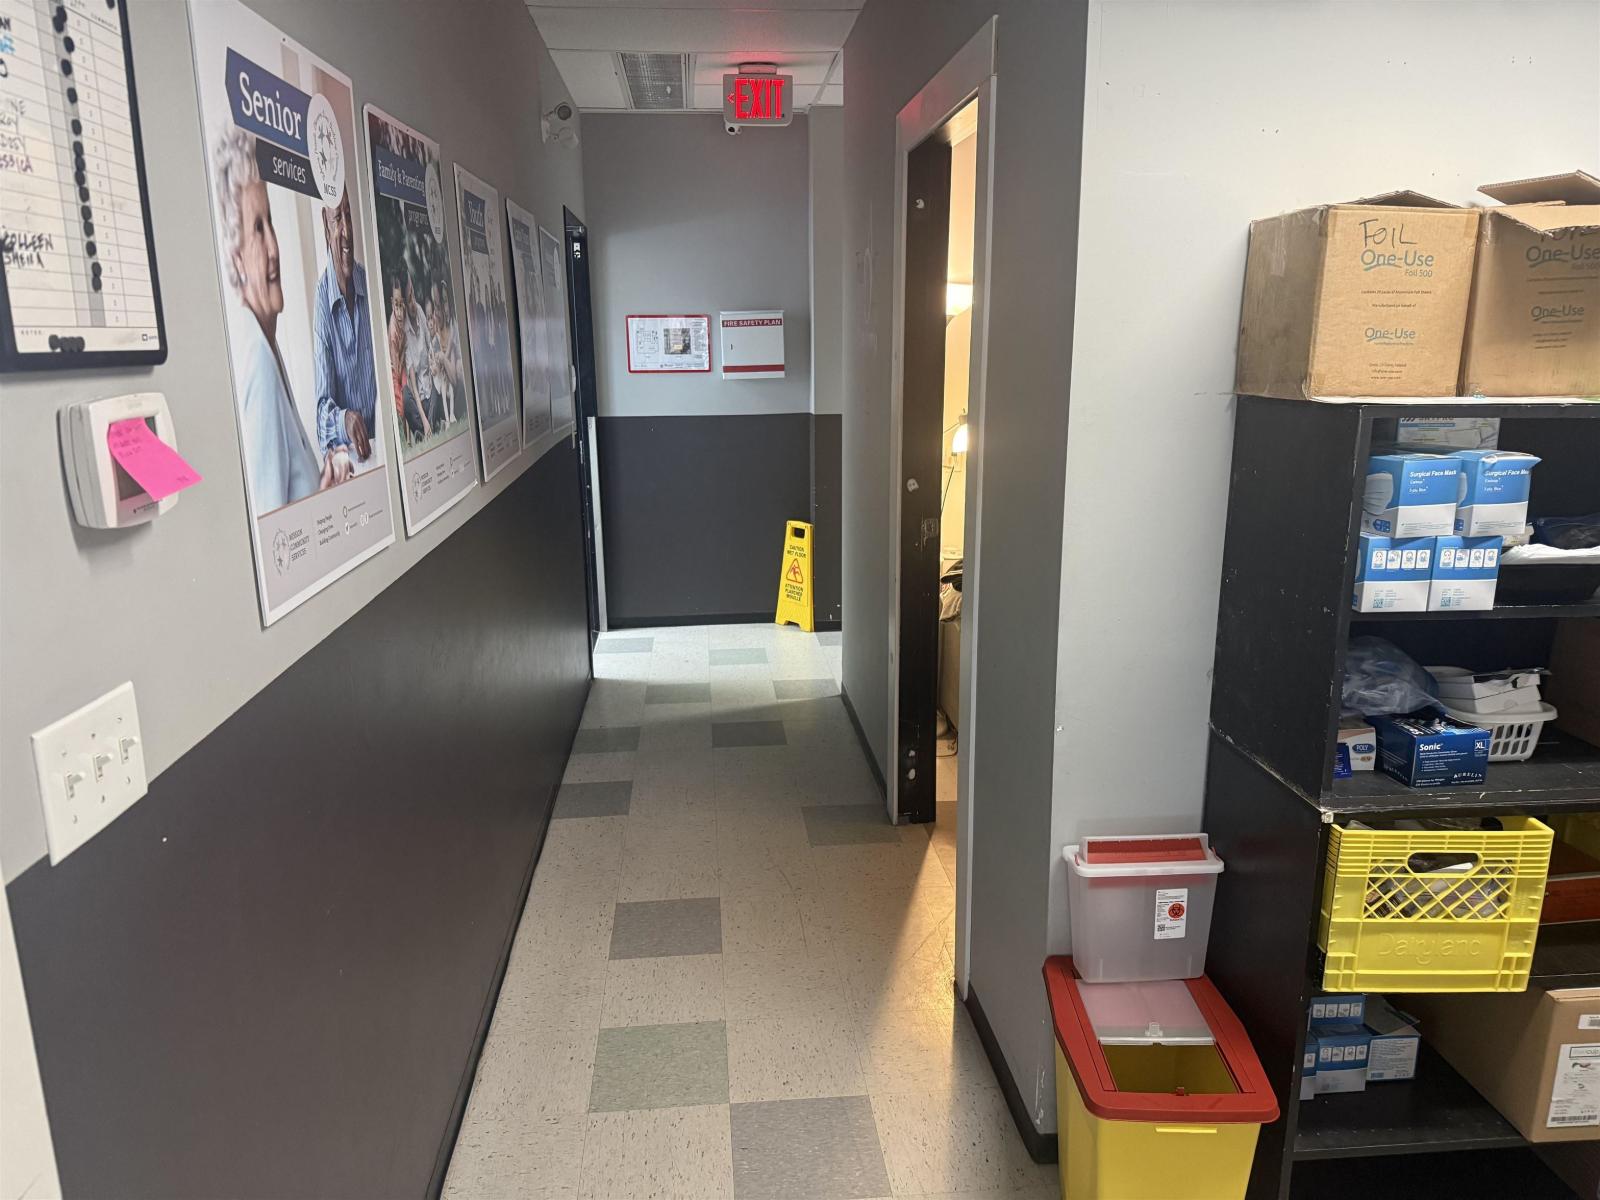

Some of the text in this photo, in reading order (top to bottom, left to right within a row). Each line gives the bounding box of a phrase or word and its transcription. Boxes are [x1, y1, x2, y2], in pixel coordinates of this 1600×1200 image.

[240, 71, 302, 140] Senior
[735, 78, 784, 119] EXIT
[273, 156, 306, 184] services
[378, 160, 397, 188] Family
[1359, 218, 1418, 249] FOIL
[1361, 249, 1434, 270] One-Use
[1526, 244, 1600, 267] One-Use
[1404, 269, 1433, 277] Foil 500
[1531, 304, 1584, 320] One-Use
[1365, 327, 1416, 341] One-Use
[1419, 741, 1486, 751] Sonic XL
